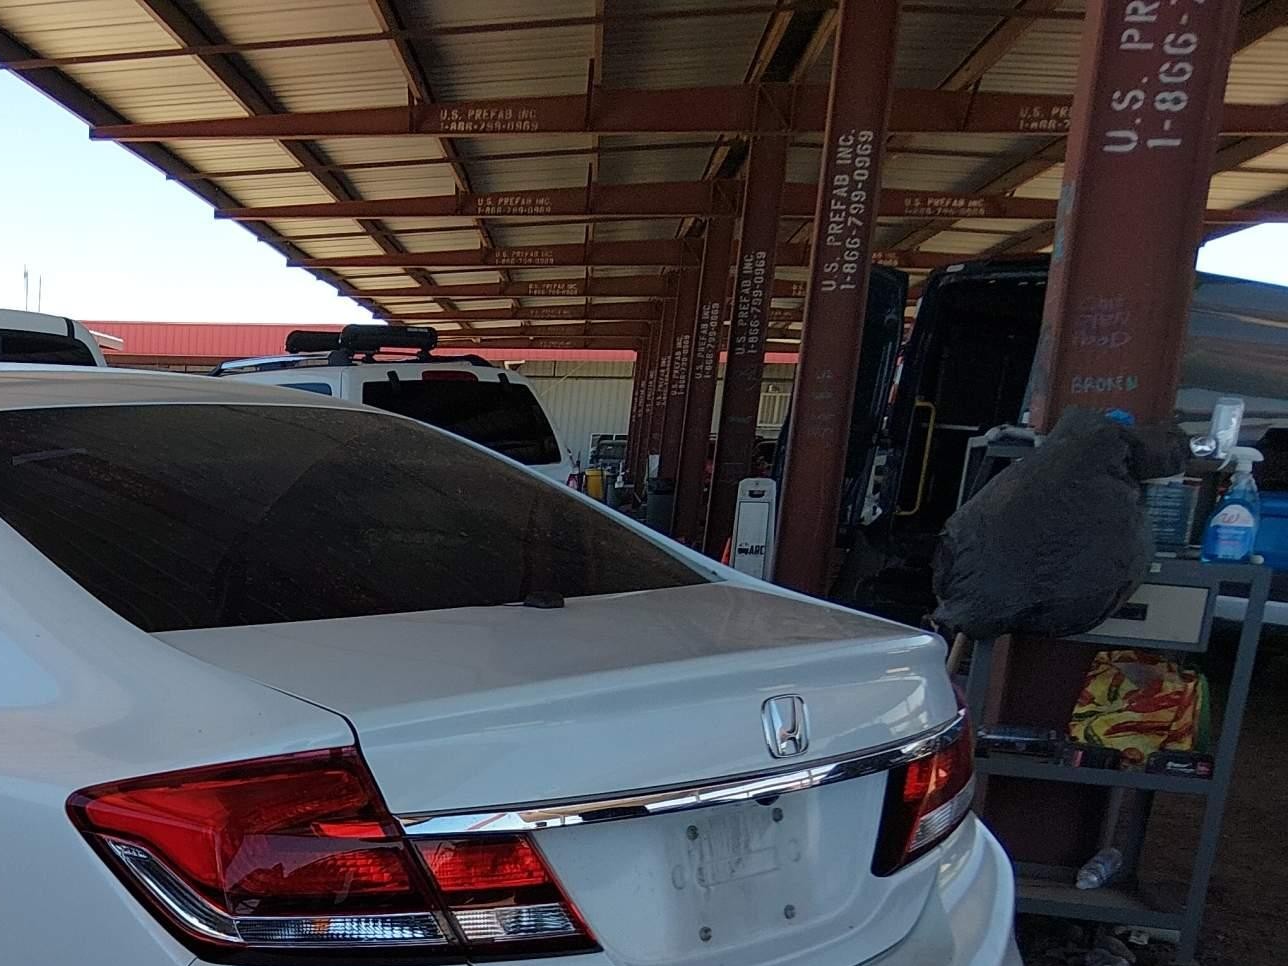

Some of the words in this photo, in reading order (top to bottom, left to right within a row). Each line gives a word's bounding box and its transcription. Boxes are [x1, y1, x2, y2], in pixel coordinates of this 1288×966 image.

[1119, 1, 1161, 49] PR
[1146, 0, 1206, 149] 1-866-
[467, 108, 513, 120] PREFAB
[1103, 77, 1148, 152] U.S.
[836, 129, 856, 165] INC.
[826, 173, 850, 246] PREFAB
[840, 130, 874, 290] 1-866-799-0969
[821, 257, 841, 291] U.S.
[738, 279, 752, 327] PREFAB
